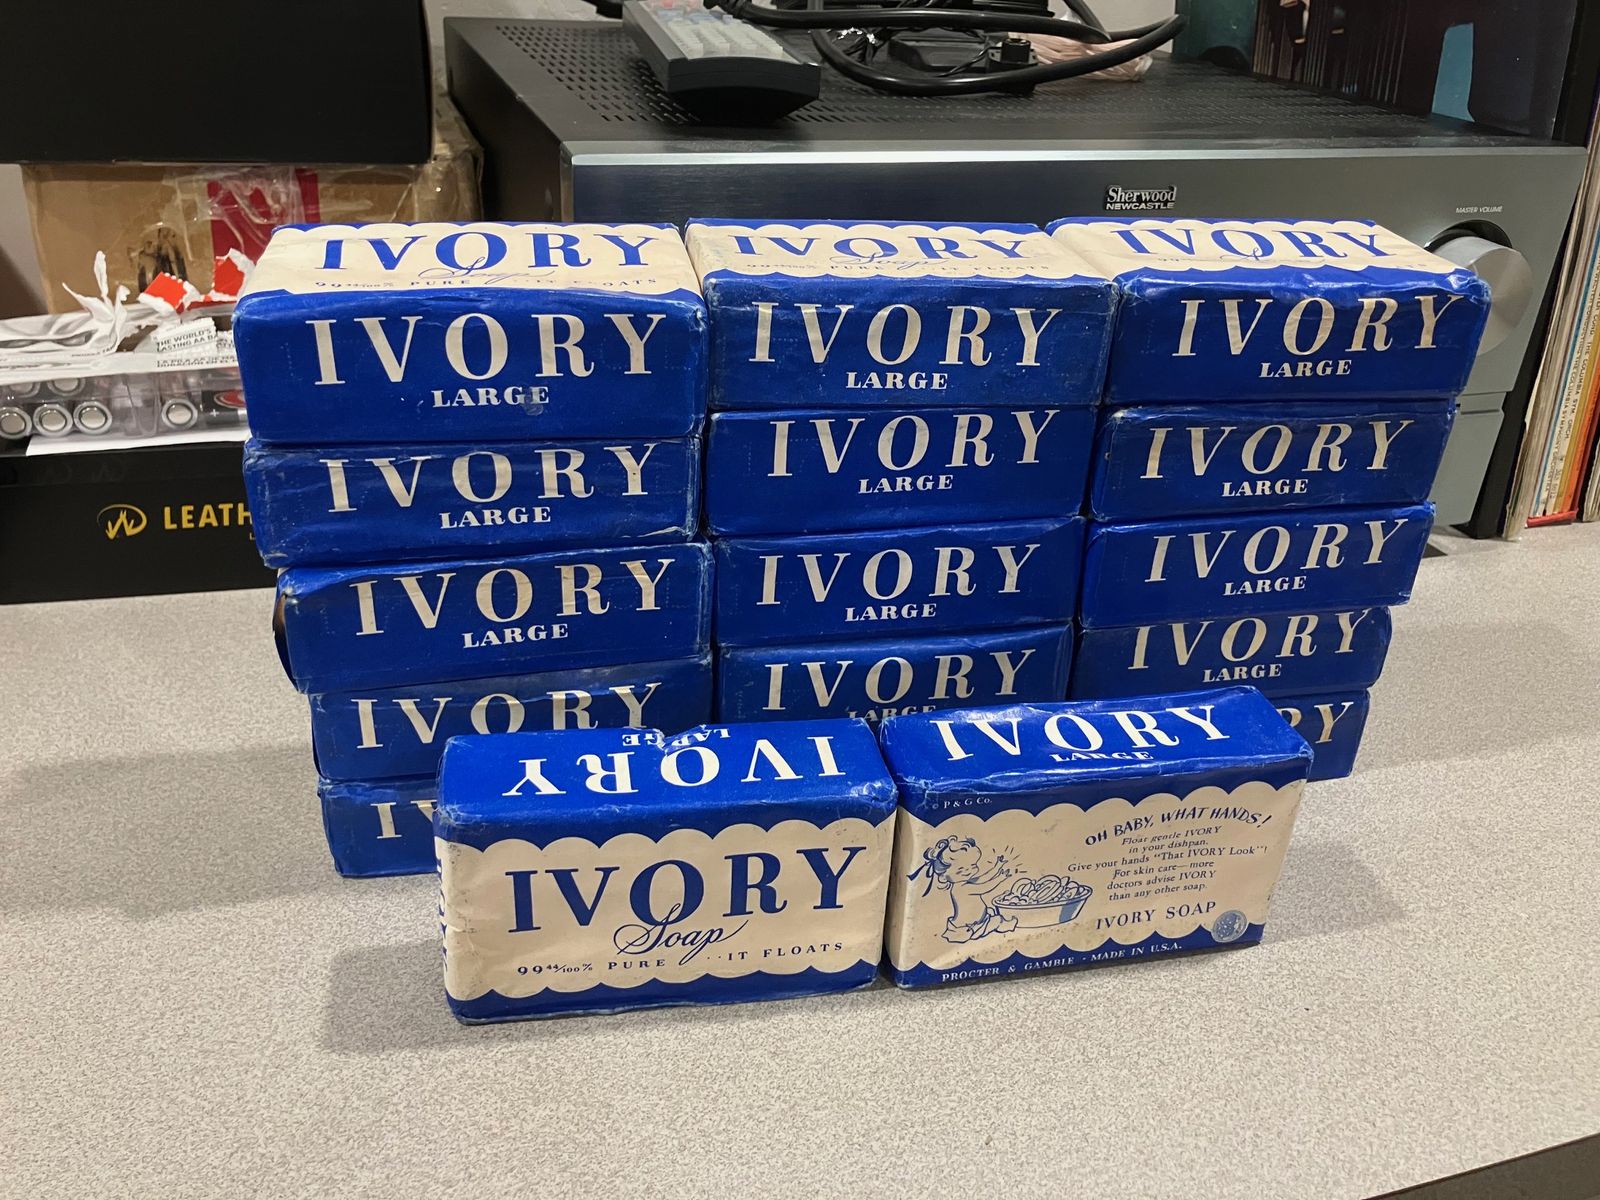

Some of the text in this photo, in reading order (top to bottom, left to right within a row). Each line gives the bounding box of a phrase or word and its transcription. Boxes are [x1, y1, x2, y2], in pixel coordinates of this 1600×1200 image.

[1106, 185, 1177, 202] Sherwood
[1106, 202, 1175, 210] NEWCASTLE
[314, 231, 659, 271] IVORY
[728, 234, 1032, 260] IVORY
[1110, 228, 1397, 258] IVORY
[748, 301, 1063, 366] IVORY
[1172, 294, 1464, 357] IVORY
[305, 312, 666, 385] IVORY
[846, 371, 949, 389] LARGE
[1259, 359, 1352, 378] LARGE
[1575, 359, 1588, 395] COLUMBIA
[431, 386, 549, 408] LARGE
[768, 409, 1060, 477] IVORY
[1140, 419, 1415, 479] IVORY
[320, 443, 657, 513] IVORY
[858, 474, 954, 494] LARGE
[1221, 478, 1309, 497] LARGE
[440, 506, 551, 529] LARGE
[1144, 518, 1409, 583] IVORY
[756, 543, 1040, 605] IVORY
[1223, 575, 1307, 596] LARGE
[349, 558, 675, 636] IVORY
[845, 603, 937, 622] LARGE
[463, 623, 569, 649] LARGE
[1127, 607, 1372, 670] IVORY
[762, 649, 1036, 711] IVORY
[1202, 663, 1282, 683] LARGE
[351, 682, 662, 749] IVORY
[930, 705, 1230, 762] IVORY
[502, 735, 846, 797] IVORY
[1049, 751, 1154, 762] LARGE
[944, 801, 951, 809] P
[953, 800, 960, 808] &
[964, 797, 973, 806] G
[1084, 829, 1108, 846] OH
[1114, 815, 1154, 837] BABY,
[1161, 807, 1206, 823] WHAT
[1122, 825, 1222, 846] Float gentle IVORY
[1067, 862, 1094, 872] Give
[1095, 859, 1118, 871] your
[1121, 855, 1150, 865] hands
[1187, 847, 1226, 858] IVORY
[1128, 837, 1209, 854] in your dishpan.
[1107, 869, 1217, 890] doctors advise IVORY
[1112, 868, 1132, 879] For
[1133, 865, 1155, 876] skin
[505, 846, 866, 934] IVORY
[1109, 882, 1208, 901] than any other soap.
[1096, 901, 1217, 930] IVORY SOAP
[613, 902, 749, 966] Soap
[607, 959, 666, 970] PURE
[763, 942, 843, 958] FLOATS
[942, 966, 1000, 982] PROCTER
[1008, 963, 1017, 973] &
[1090, 949, 1126, 961] MADE
[1131, 946, 1145, 956] IN
[1151, 942, 1183, 954] U.S.A.
